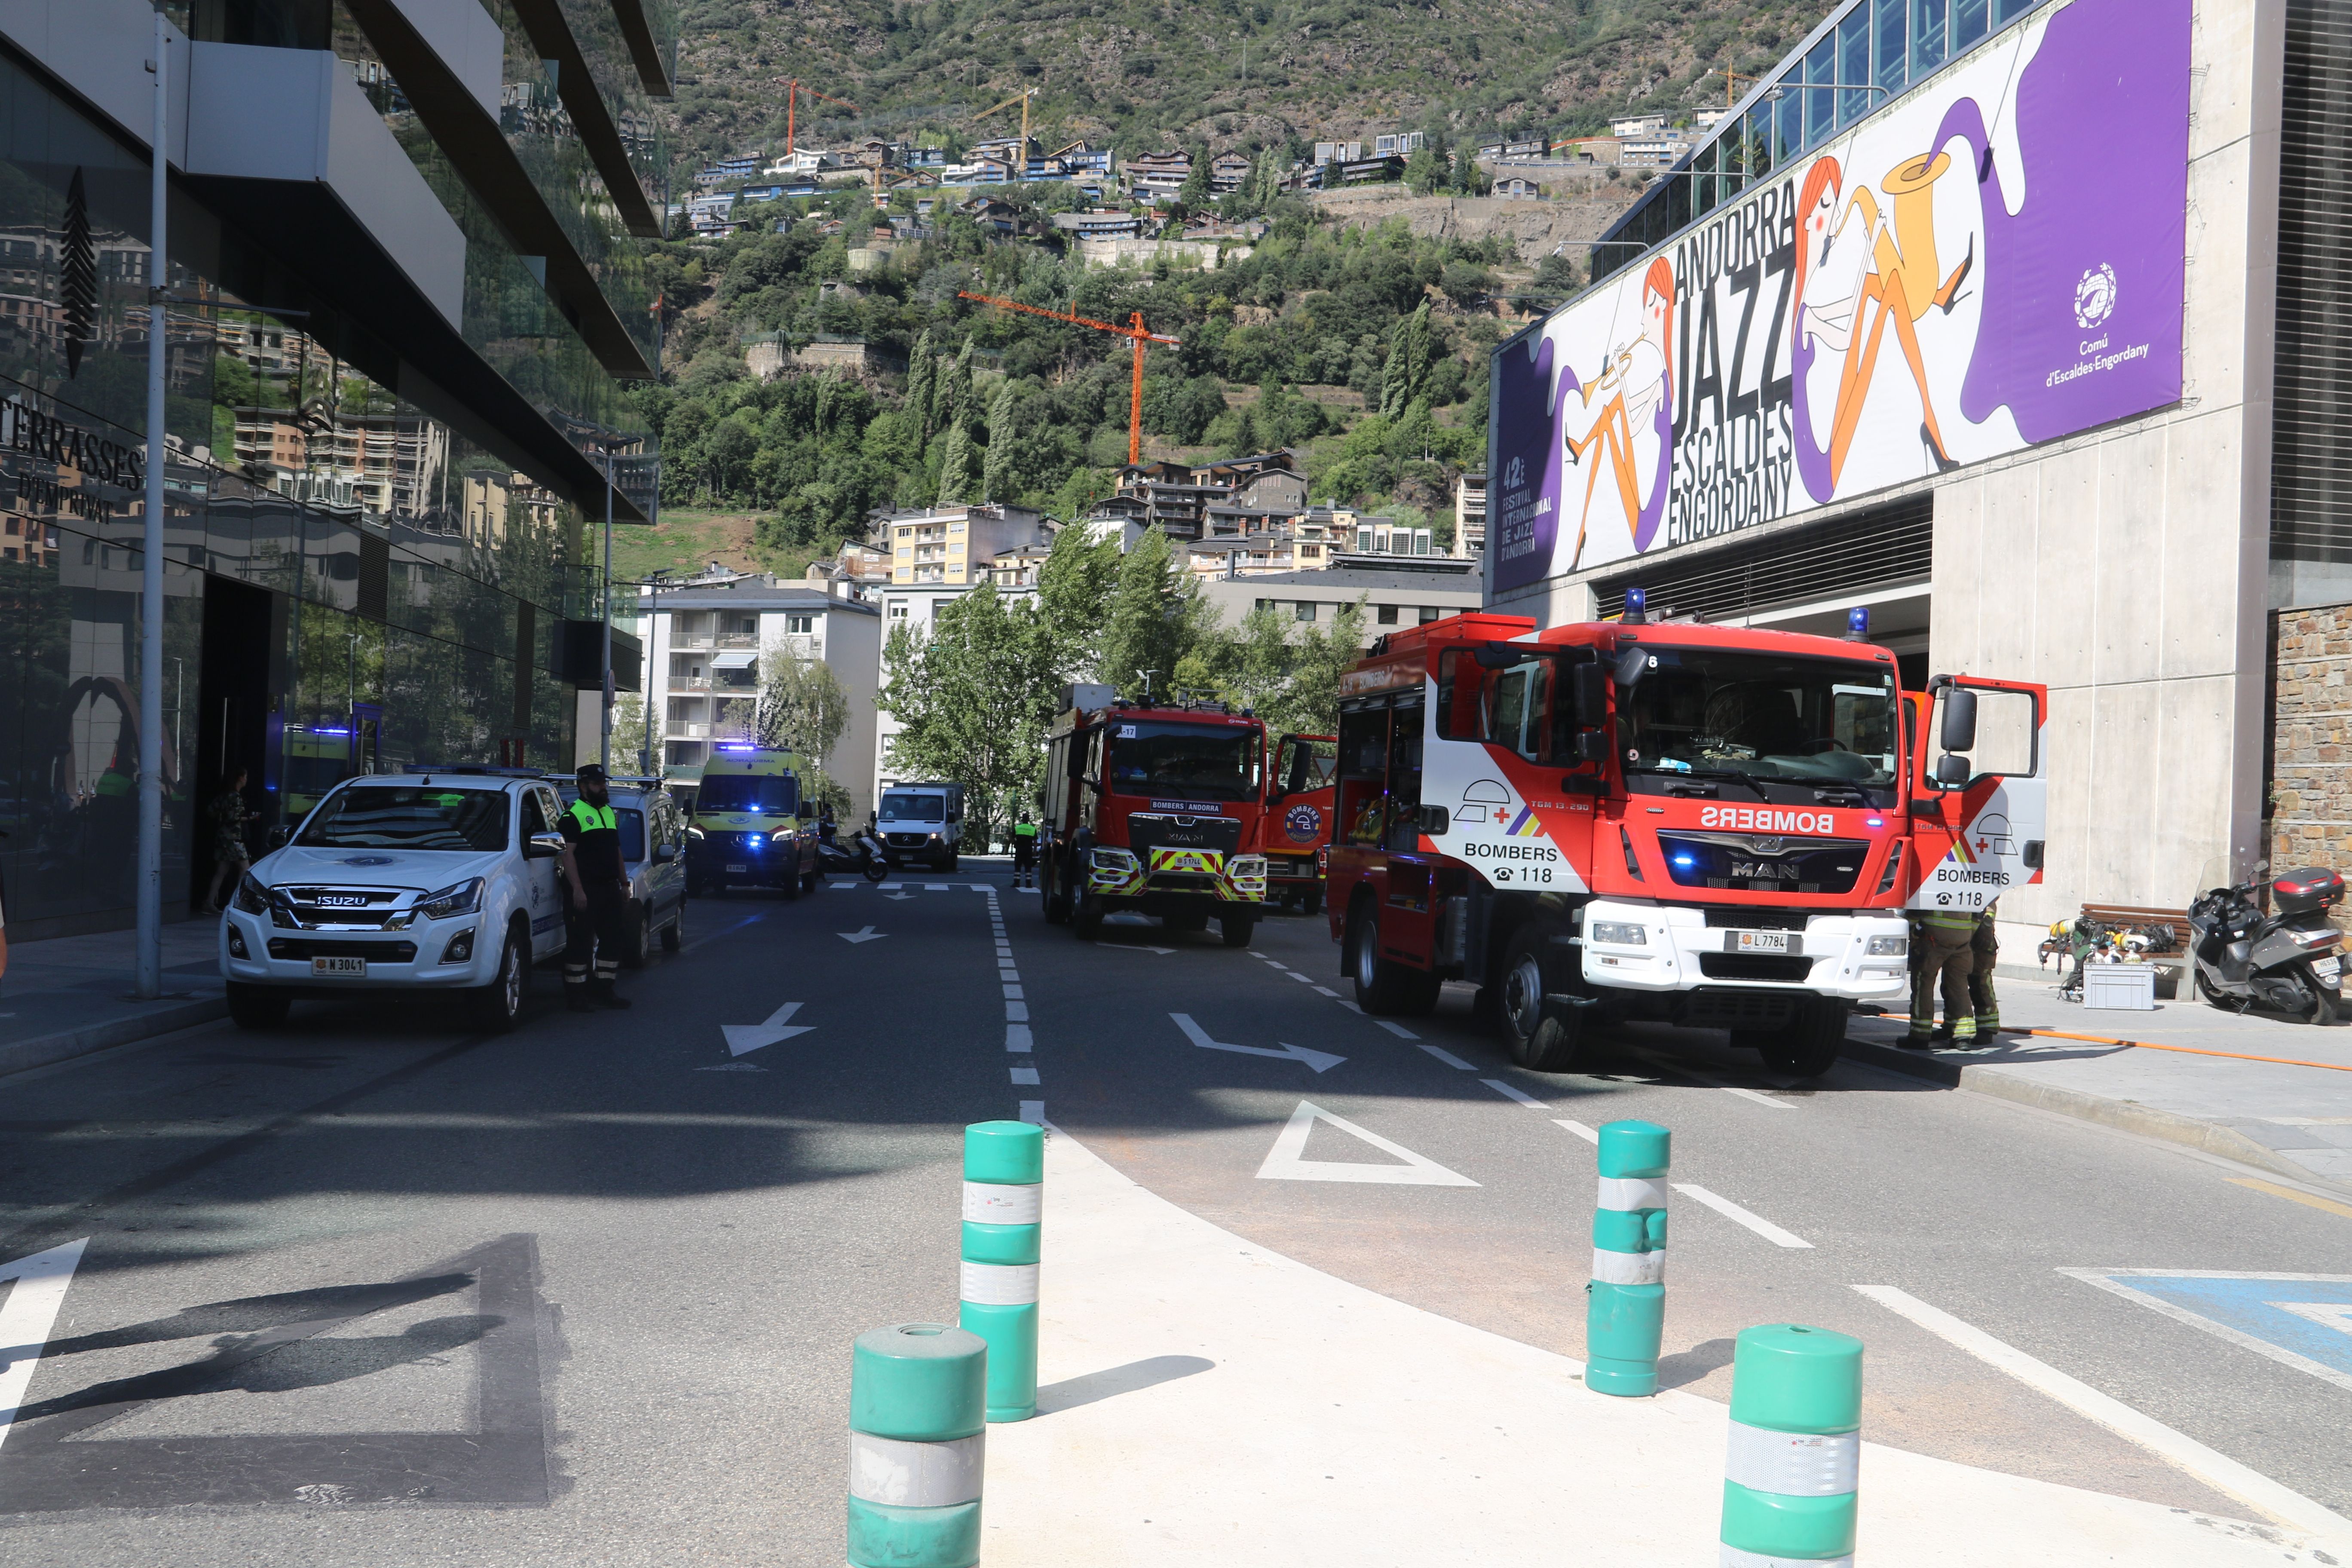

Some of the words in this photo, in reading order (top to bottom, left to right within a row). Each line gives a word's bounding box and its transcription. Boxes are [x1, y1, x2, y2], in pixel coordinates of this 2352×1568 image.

[1673, 176, 1796, 306] ANDORRA
[1671, 245, 1796, 442] JAZZ
[2079, 333, 2108, 355] Comú
[0, 397, 141, 491] TERRASSES
[1670, 399, 1792, 496] ESCALDES
[18, 472, 113, 525] D'EMPRIVAT
[1503, 488, 1531, 512] FESTIVAL
[1668, 459, 1792, 547] ENGORDANY
[1503, 496, 1552, 528] INTERNACIONAL
[1502, 529, 1511, 545] DE
[1514, 521, 1533, 540] JAZZ
[1501, 537, 1535, 561] D'ANDORRA
[1360, 670, 1384, 689] BOMBERS
[1188, 804, 1219, 812] ANDORRA
[1288, 806, 1319, 820] BOMBERS
[1166, 833, 1203, 842] MAN
[1289, 832, 1315, 842] ANDORRA
[1464, 843, 1557, 862] BOMBERS
[1521, 867, 1552, 882] 118
[1732, 862, 1799, 879] MAN
[1938, 869, 2009, 885] BOMBERS
[317, 896, 366, 905] ISUZU
[1957, 891, 1991, 906] 118
[1755, 935, 1759, 946] L
[1763, 936, 1784, 947] 7784
[330, 959, 335, 970] N
[338, 959, 362, 971] 3041
